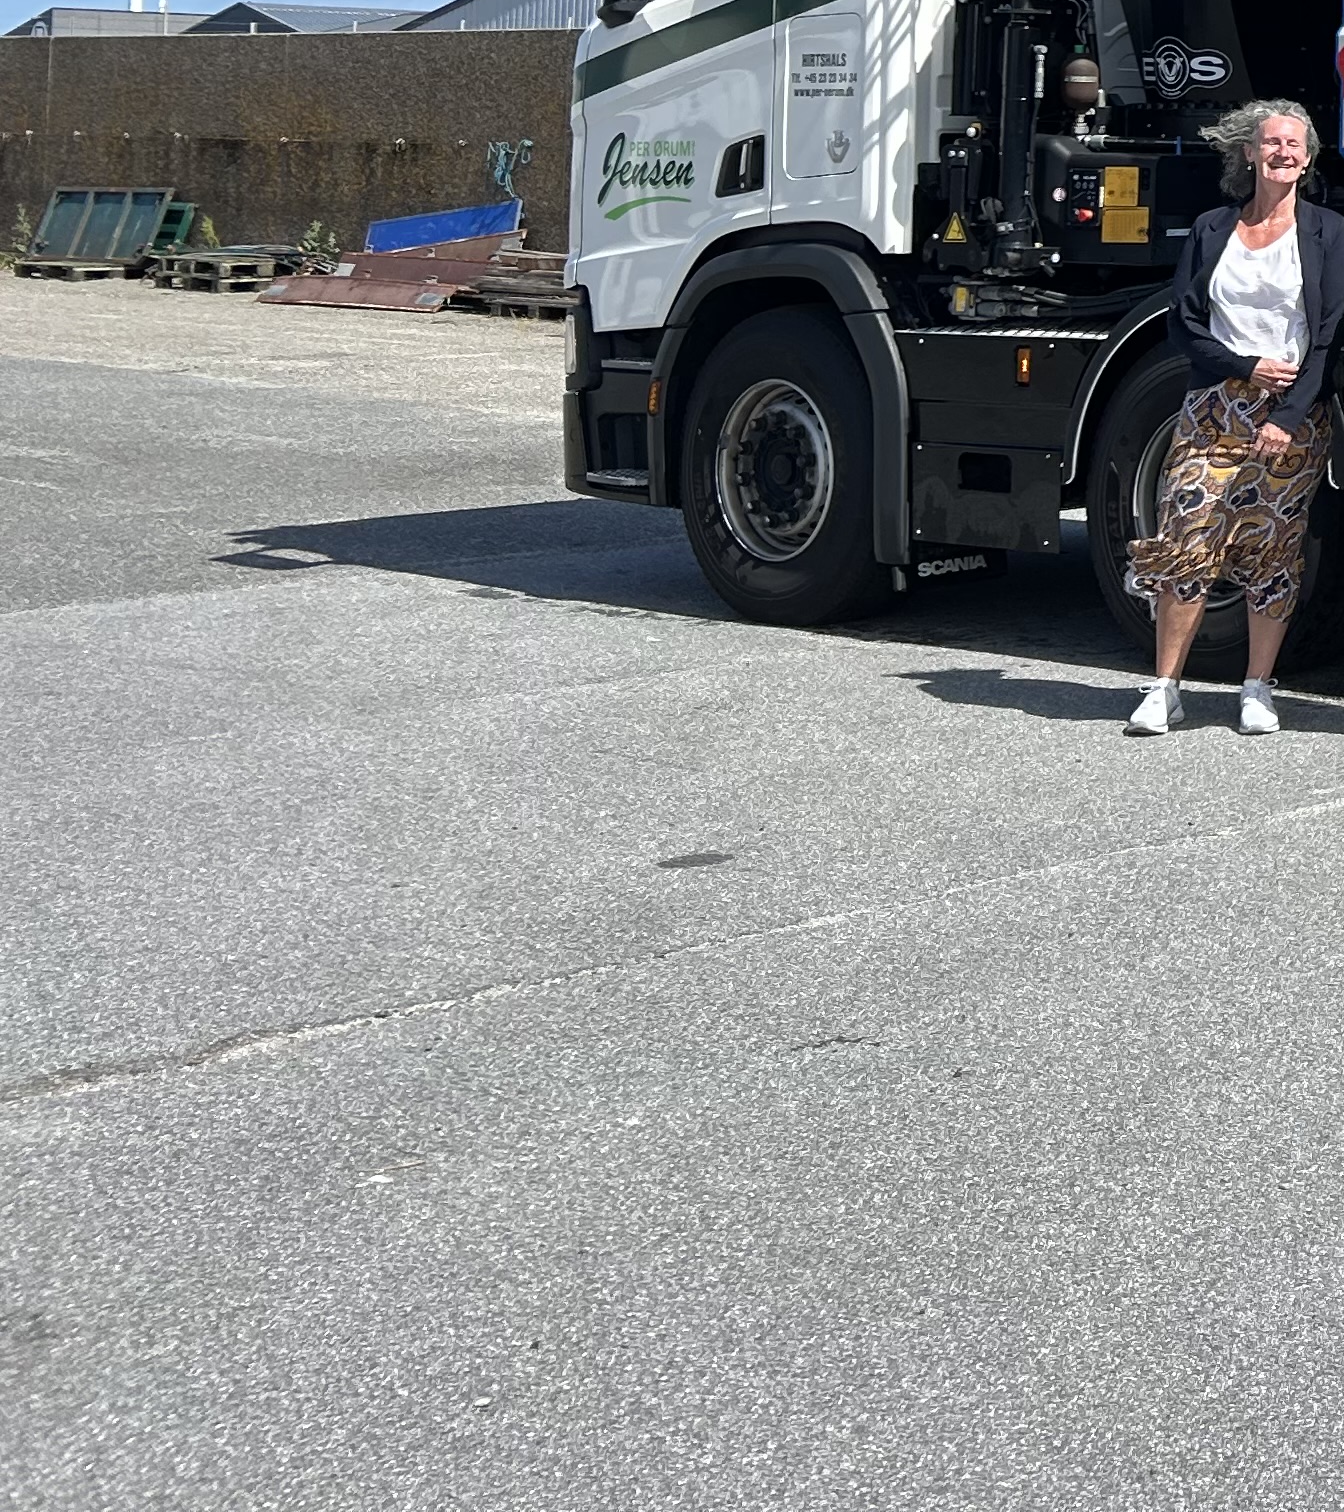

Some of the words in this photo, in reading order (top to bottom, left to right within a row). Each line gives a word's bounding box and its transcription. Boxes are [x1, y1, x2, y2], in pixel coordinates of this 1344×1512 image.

[818, 72, 827, 84] 23
[828, 72, 837, 84] 23
[838, 72, 847, 84] 34
[848, 72, 858, 84] 34
[629, 140, 650, 157] PER
[653, 140, 691, 157] ØRUM
[597, 131, 695, 207] Jensen
[917, 554, 988, 578] SCANIA
